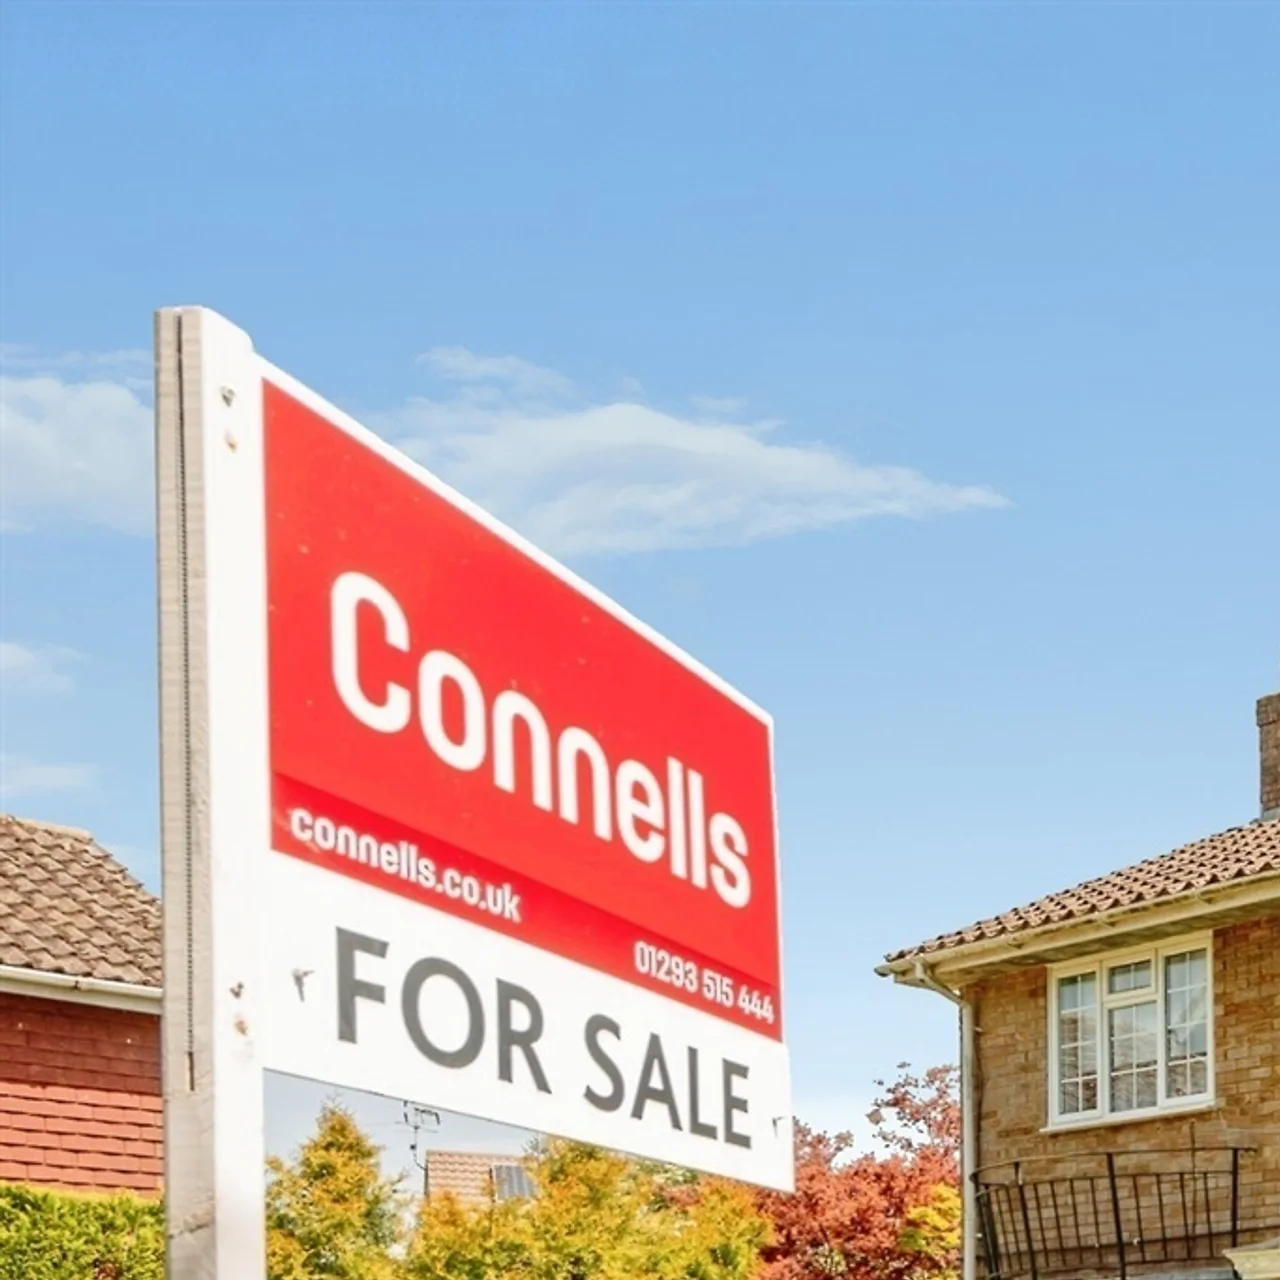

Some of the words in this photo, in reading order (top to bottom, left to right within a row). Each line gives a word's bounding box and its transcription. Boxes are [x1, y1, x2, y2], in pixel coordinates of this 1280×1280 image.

[331, 572, 751, 908] Connells
[290, 808, 522, 923] connells.co.uk
[336, 926, 552, 1094] FOR
[584, 1014, 752, 1149] SALE
[634, 940, 699, 994] 01293
[703, 968, 734, 1008] 515
[737, 985, 774, 1024] 444
